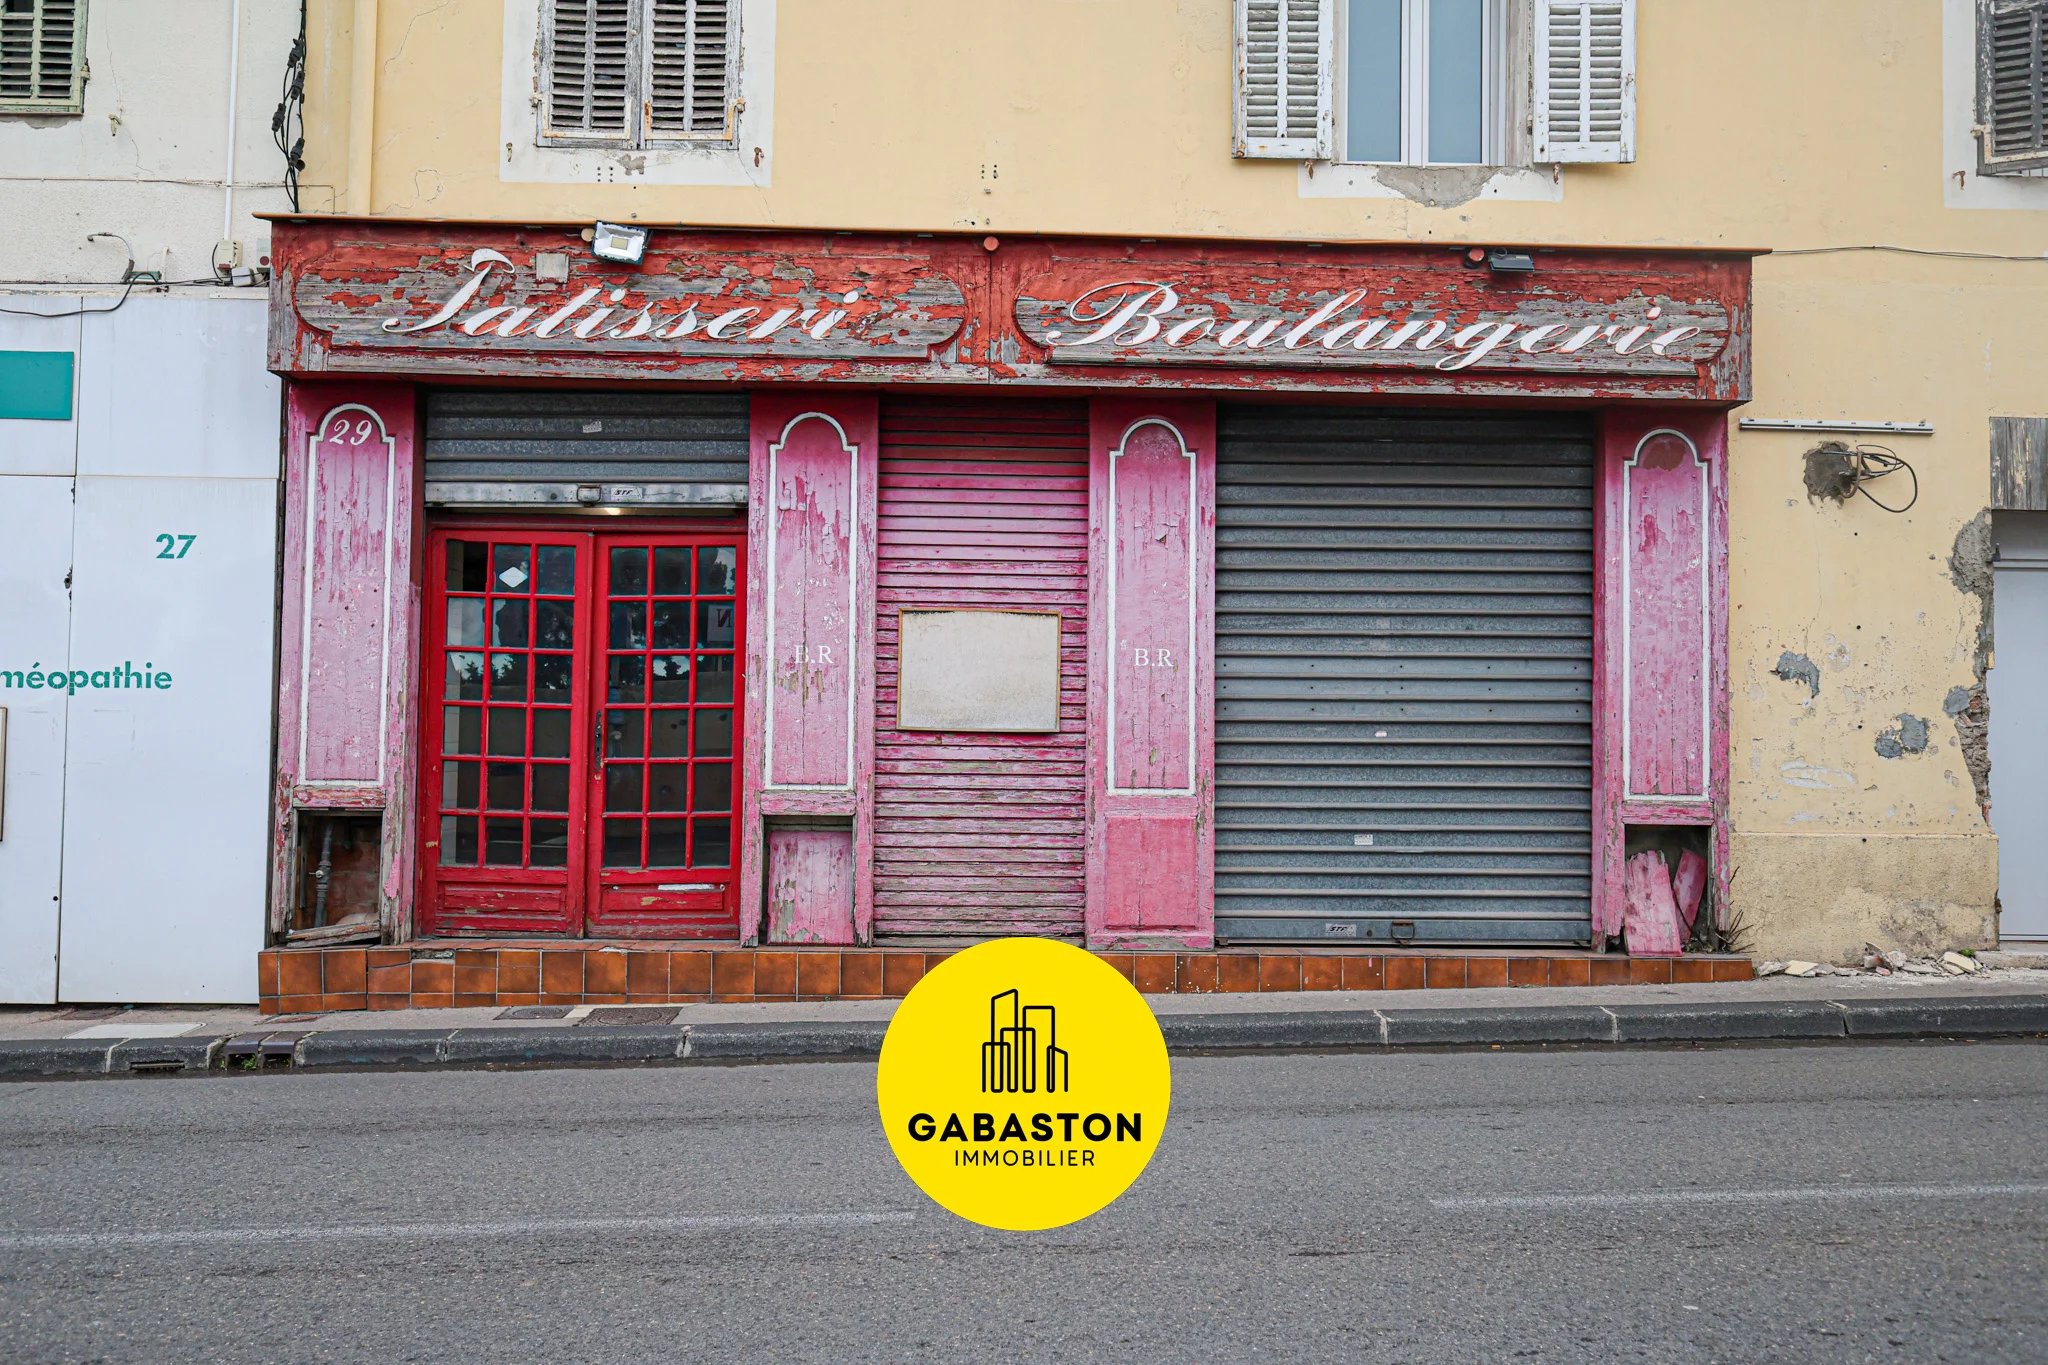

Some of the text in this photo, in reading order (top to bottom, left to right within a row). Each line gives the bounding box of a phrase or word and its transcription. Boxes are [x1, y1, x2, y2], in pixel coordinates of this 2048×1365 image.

[1045, 280, 1701, 371] Boulangerie
[329, 419, 372, 446] 29
[155, 533, 198, 559] 27
[1134, 648, 1175, 667] B.R
[0, 661, 173, 696] méopathie
